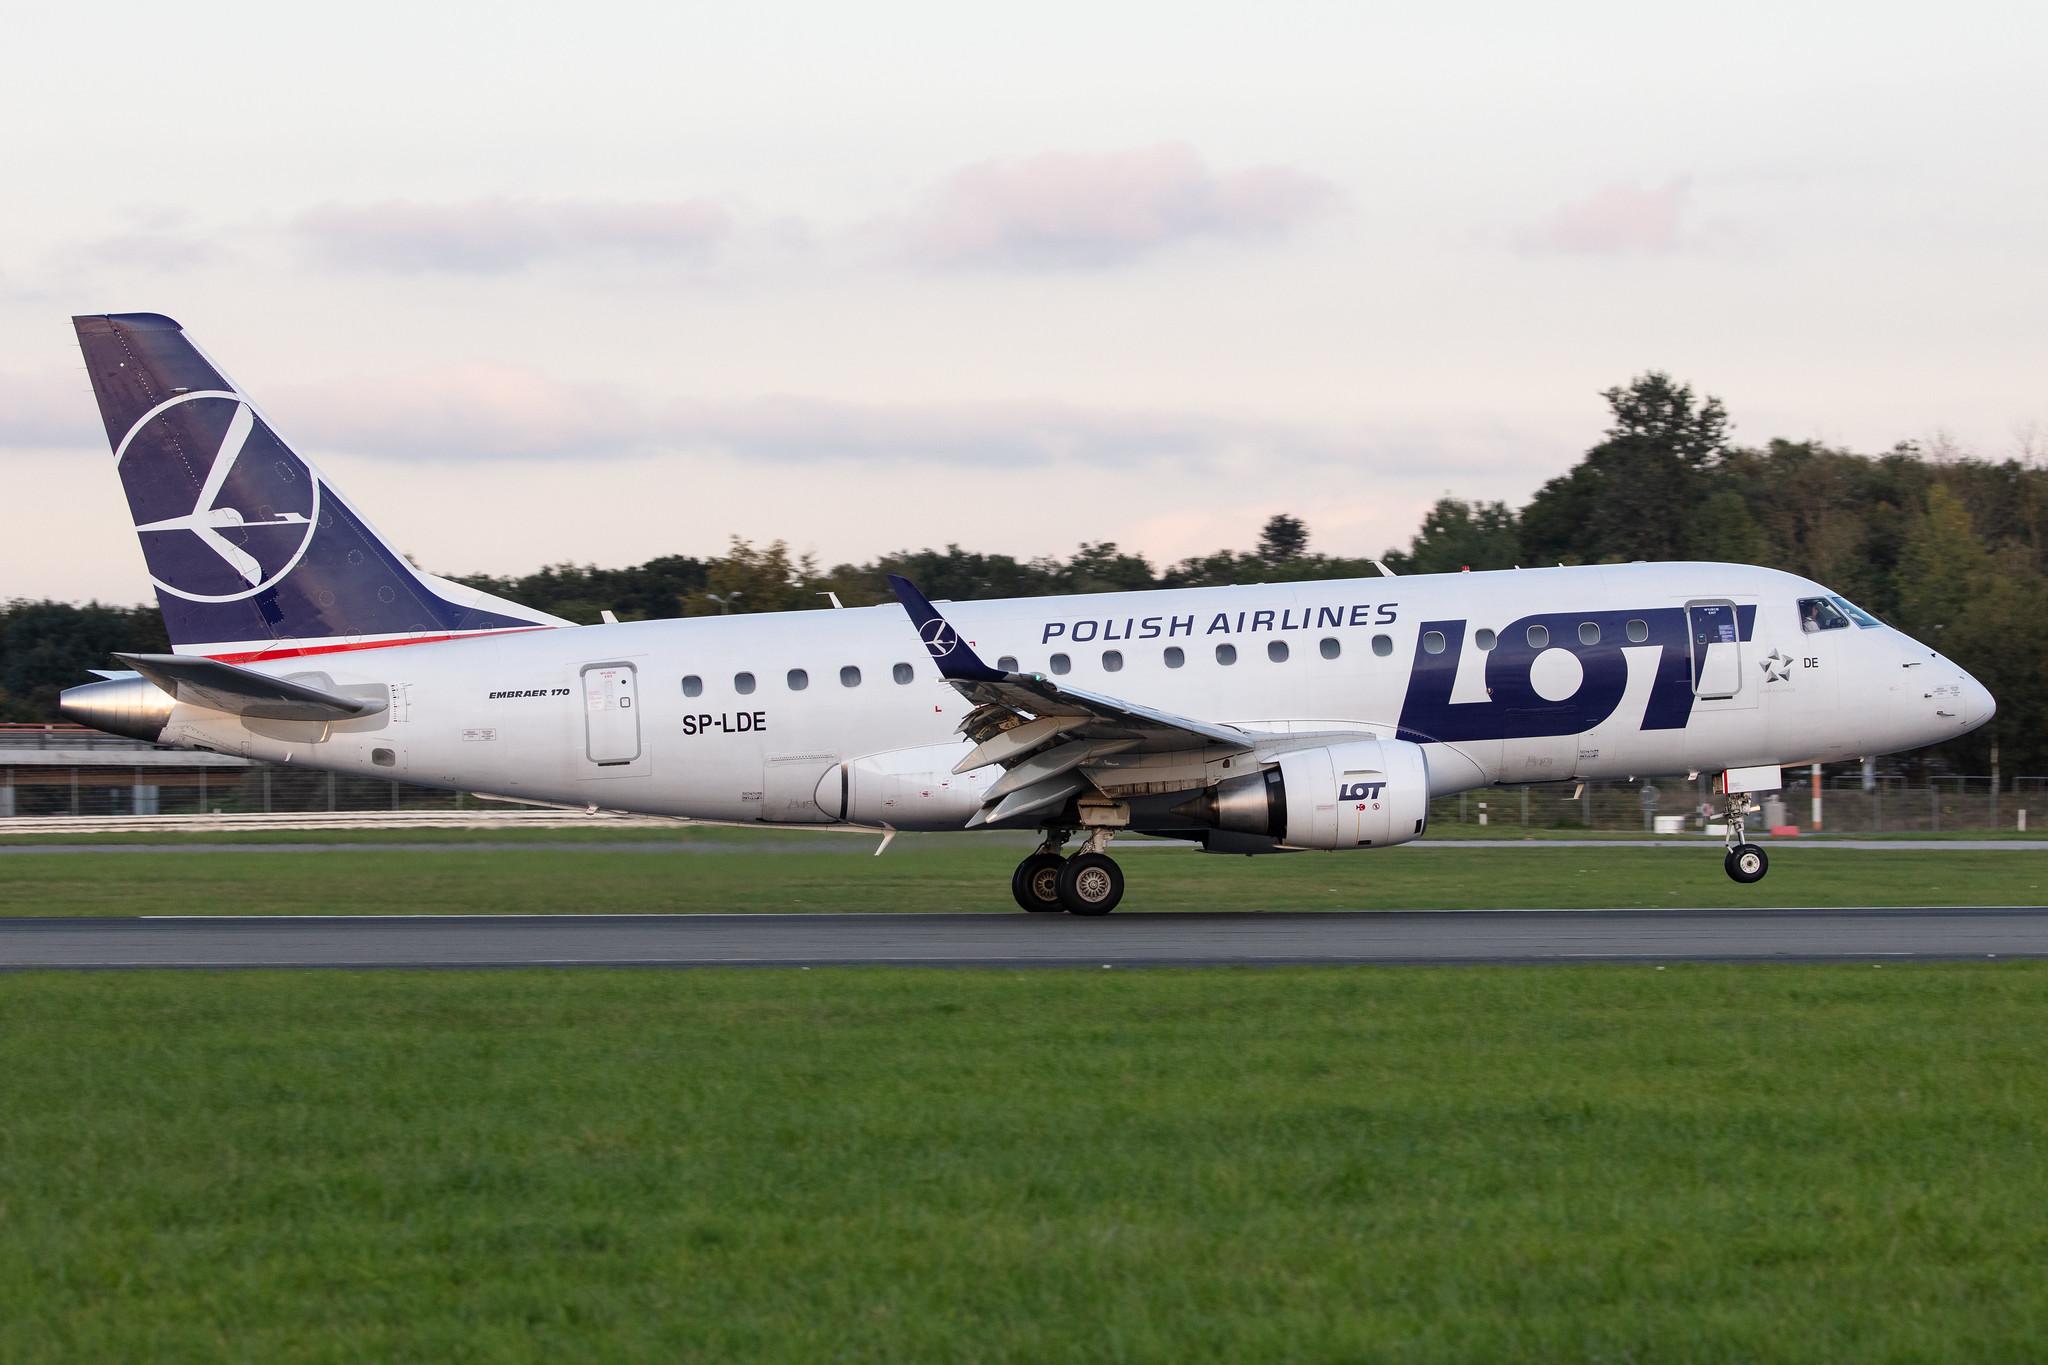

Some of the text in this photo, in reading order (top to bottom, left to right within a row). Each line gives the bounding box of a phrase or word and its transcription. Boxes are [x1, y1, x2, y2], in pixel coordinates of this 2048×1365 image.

[1041, 602, 1399, 645] POLISH AIRLINES
[1395, 604, 1758, 744] LOT
[1803, 657, 1819, 669] DE
[489, 688, 570, 699] EMBRAER 170
[682, 711, 767, 736] SP-LDE
[1338, 781, 1387, 801] LOT
